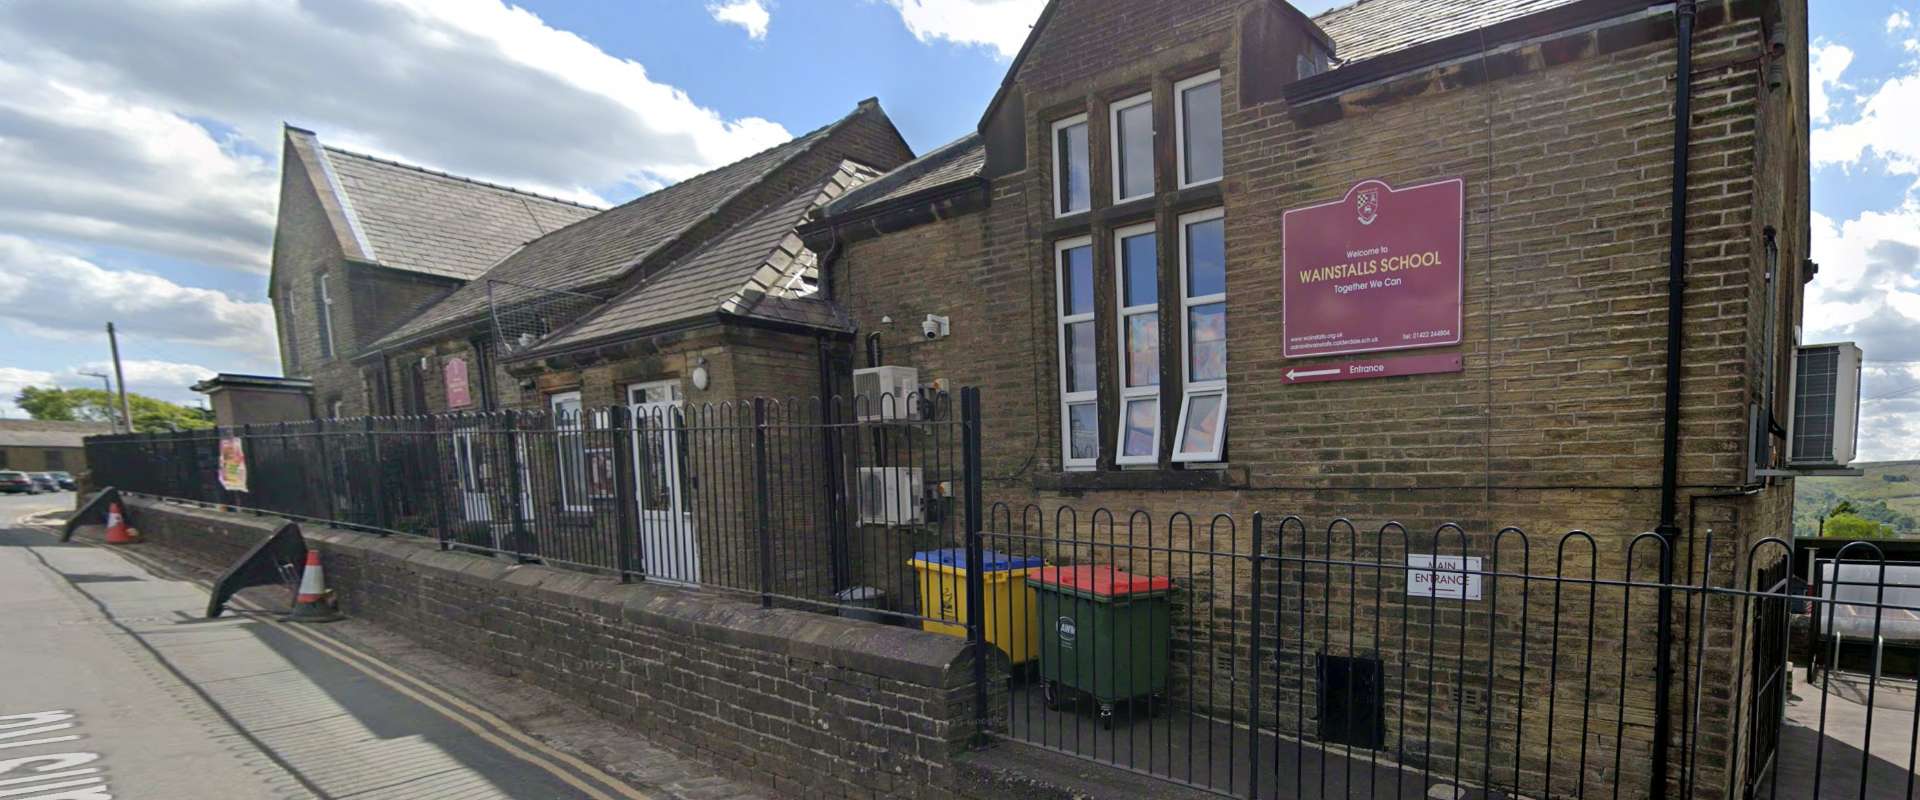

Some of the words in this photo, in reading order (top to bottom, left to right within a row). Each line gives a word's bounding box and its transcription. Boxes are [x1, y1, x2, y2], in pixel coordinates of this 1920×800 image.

[1347, 248, 1379, 258] Welcome
[1300, 259, 1377, 283] WAINSTALLS
[1380, 251, 1442, 273] SCHOOL
[1334, 282, 1368, 294] Together
[1369, 280, 1383, 288] We
[1384, 277, 1402, 287] Can
[1350, 364, 1385, 374] Entrance
